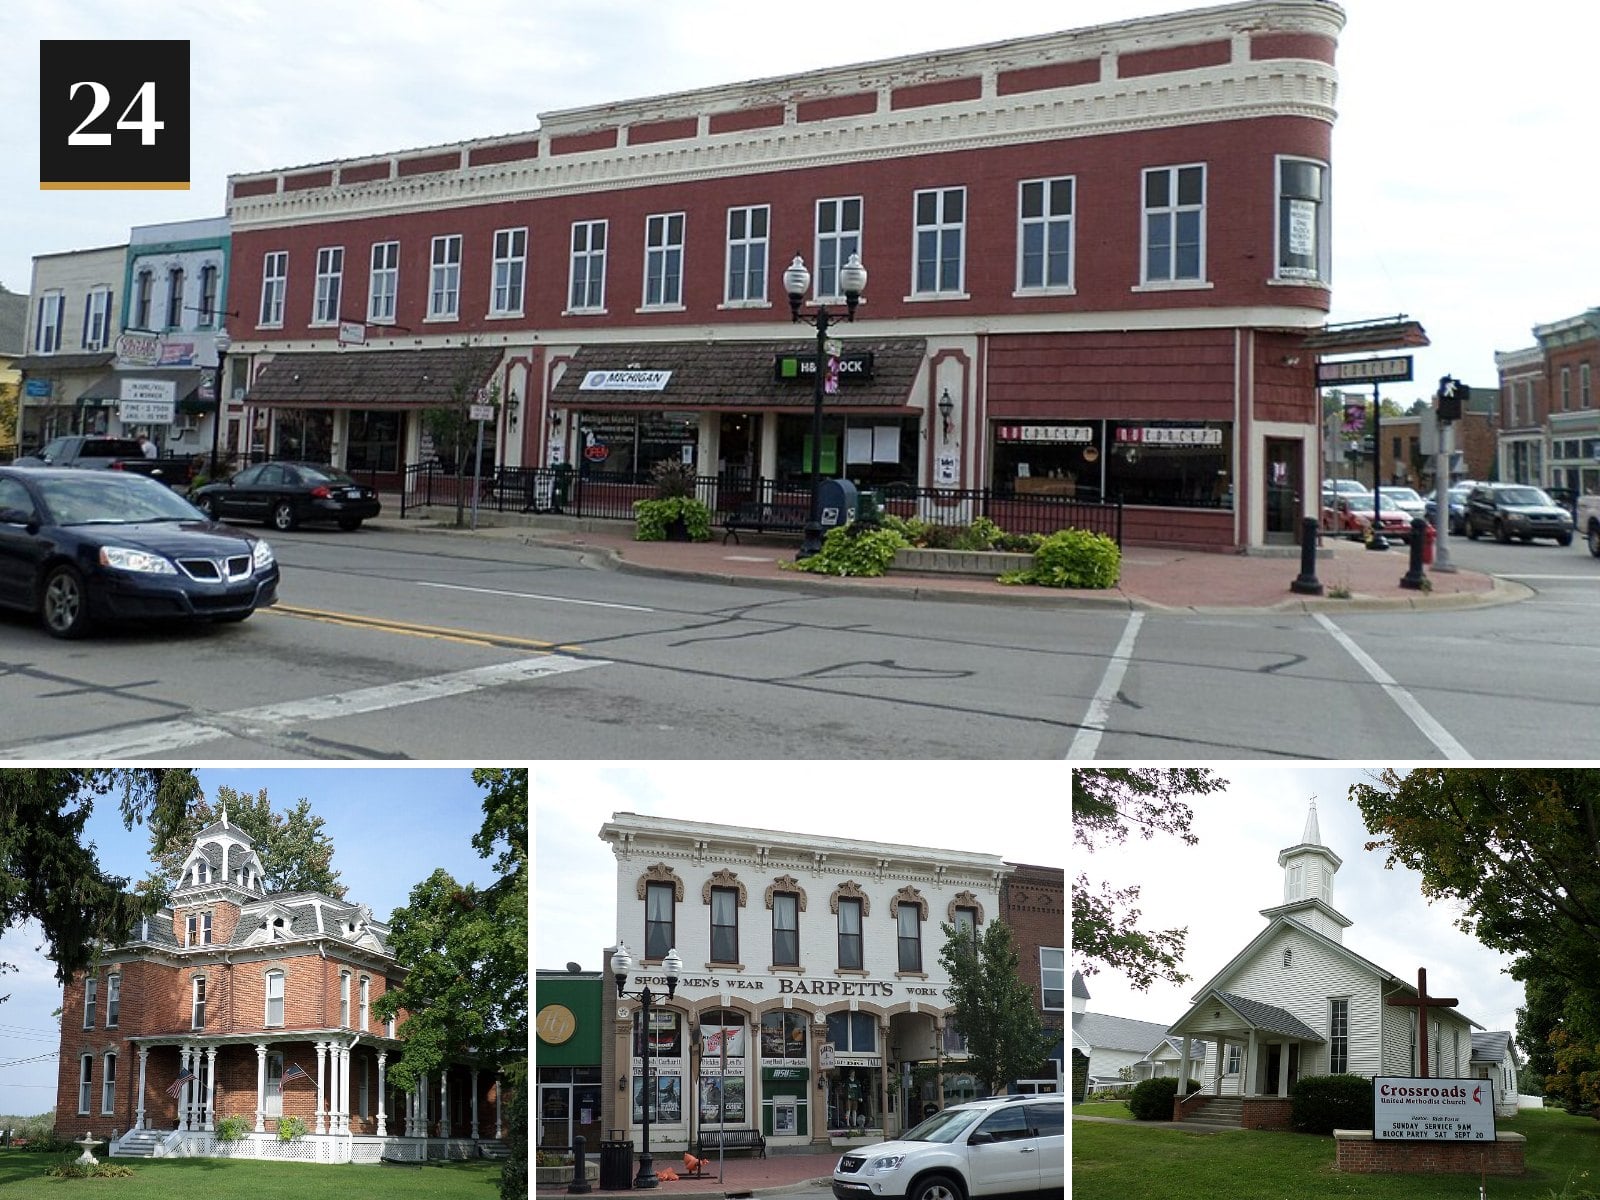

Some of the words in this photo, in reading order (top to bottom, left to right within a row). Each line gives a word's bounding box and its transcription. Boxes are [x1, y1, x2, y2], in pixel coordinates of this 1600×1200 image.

[606, 373, 663, 382] MICHIGAN
[683, 977, 720, 988] MEN'S
[726, 980, 764, 989] WEAR
[906, 986, 938, 996] WORK
[1380, 1084, 1467, 1097] Crossroads
[1392, 1122, 1418, 1130] SUNDAY
[1424, 1123, 1453, 1131] SERVICE
[1457, 1123, 1472, 1131] 9AM
[1382, 1130, 1404, 1138] BLOCK
[1406, 1131, 1428, 1139] PARTY
[1434, 1131, 1447, 1139] SAT
[1454, 1131, 1471, 1139] SEPT
